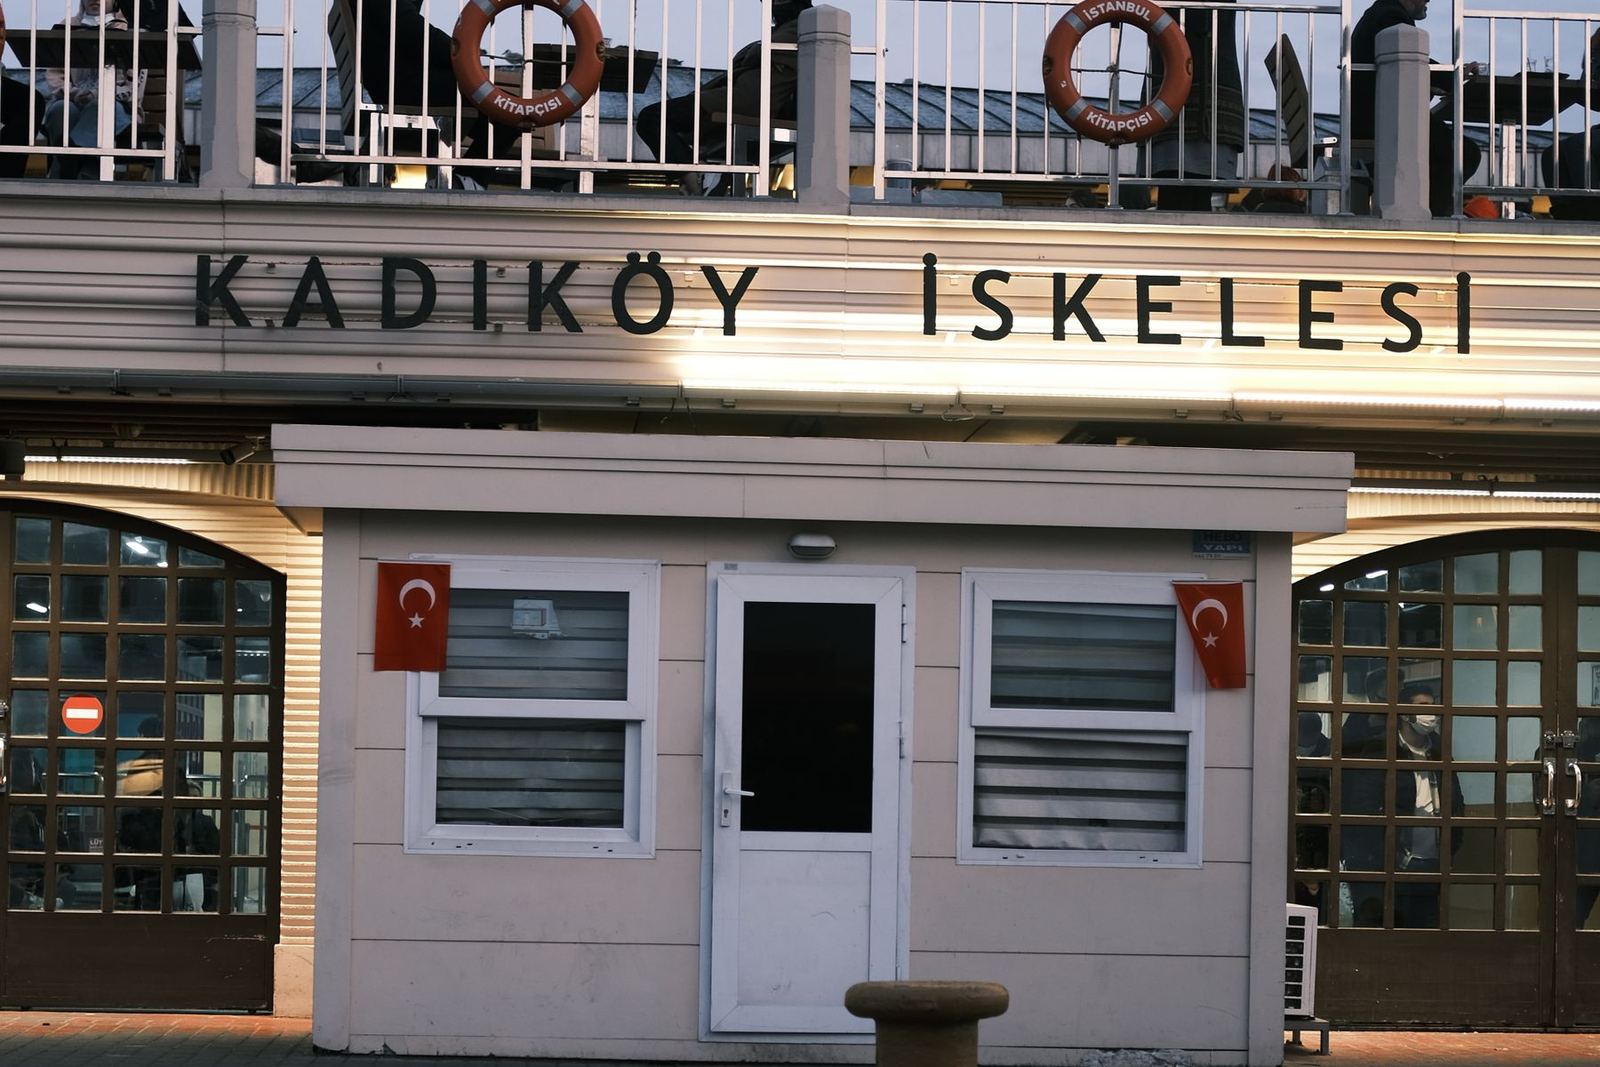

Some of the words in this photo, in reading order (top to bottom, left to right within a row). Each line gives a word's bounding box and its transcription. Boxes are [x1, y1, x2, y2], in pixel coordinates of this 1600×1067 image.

[1084, 1, 1151, 21] İSTANBUL
[494, 95, 562, 116] KİTAPÇISI
[1086, 112, 1152, 132] KİTAPÇISI
[195, 250, 760, 336] KADIKÖY
[922, 252, 1472, 355] İSKELESİ
